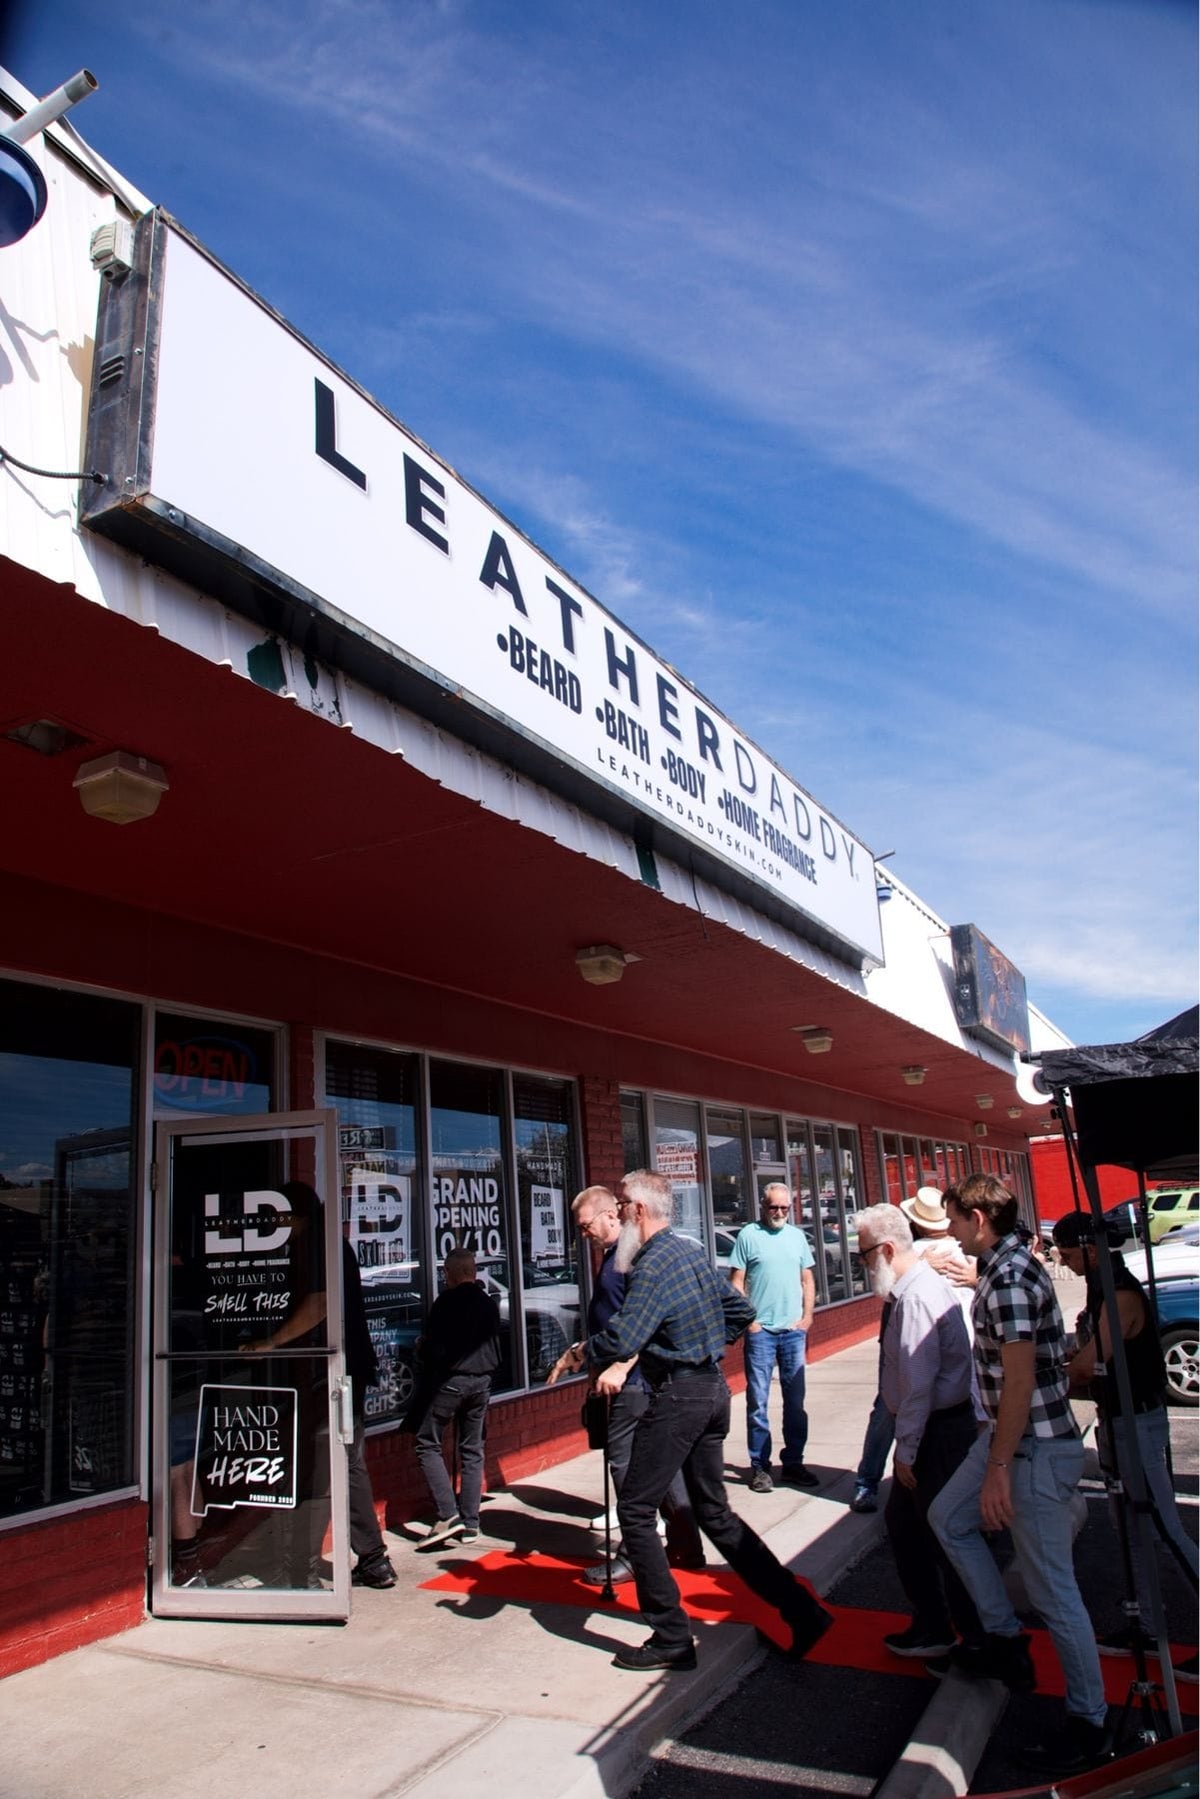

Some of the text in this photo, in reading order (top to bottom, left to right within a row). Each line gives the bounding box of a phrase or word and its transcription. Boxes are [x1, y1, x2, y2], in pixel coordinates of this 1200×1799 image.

[597, 747, 783, 880] LEATHERDADDYSKIN.COM
[763, 818, 818, 885] FRAGRANCE
[154, 1041, 248, 1099] OPEN
[533, 1192, 551, 1207] BEARD
[205, 1190, 292, 1254] LD
[540, 1212, 555, 1226] BATH
[211, 1272, 286, 1285] YOU HAVE TO
[204, 1291, 291, 1313] SMELL THIS
[366, 1317, 387, 1330] THIS
[364, 1393, 397, 1416] GHTS
[213, 1405, 279, 1428] HAND
[213, 1429, 280, 1452] MADE
[207, 1456, 285, 1487] HERE
